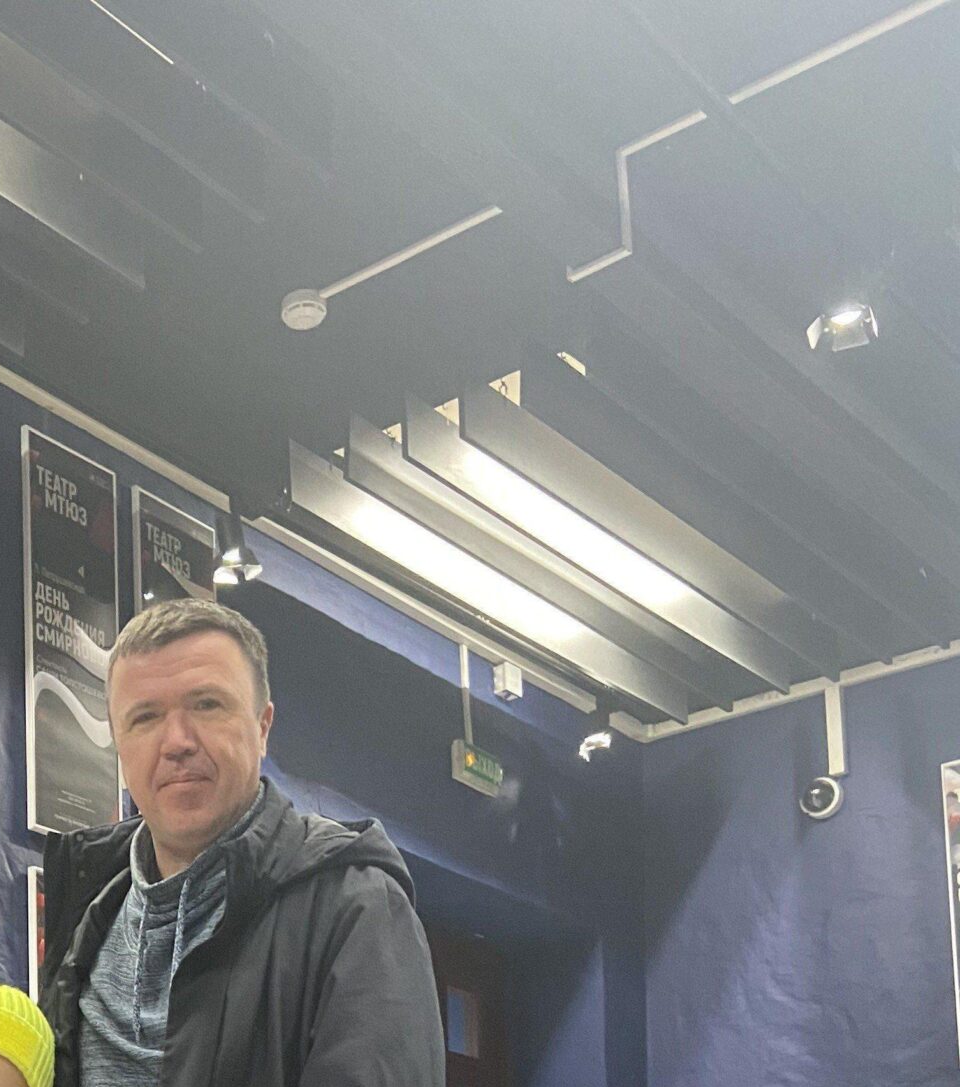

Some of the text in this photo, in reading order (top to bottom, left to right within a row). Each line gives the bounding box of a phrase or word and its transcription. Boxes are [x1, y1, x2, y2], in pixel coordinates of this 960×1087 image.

[36, 464, 78, 500] ТЕАТР
[44, 489, 88, 527] МТЮЗ
[145, 521, 182, 554] ТЕАТР
[153, 543, 191, 579] МТЮЗ
[34, 581, 70, 611] ДЕНЬ
